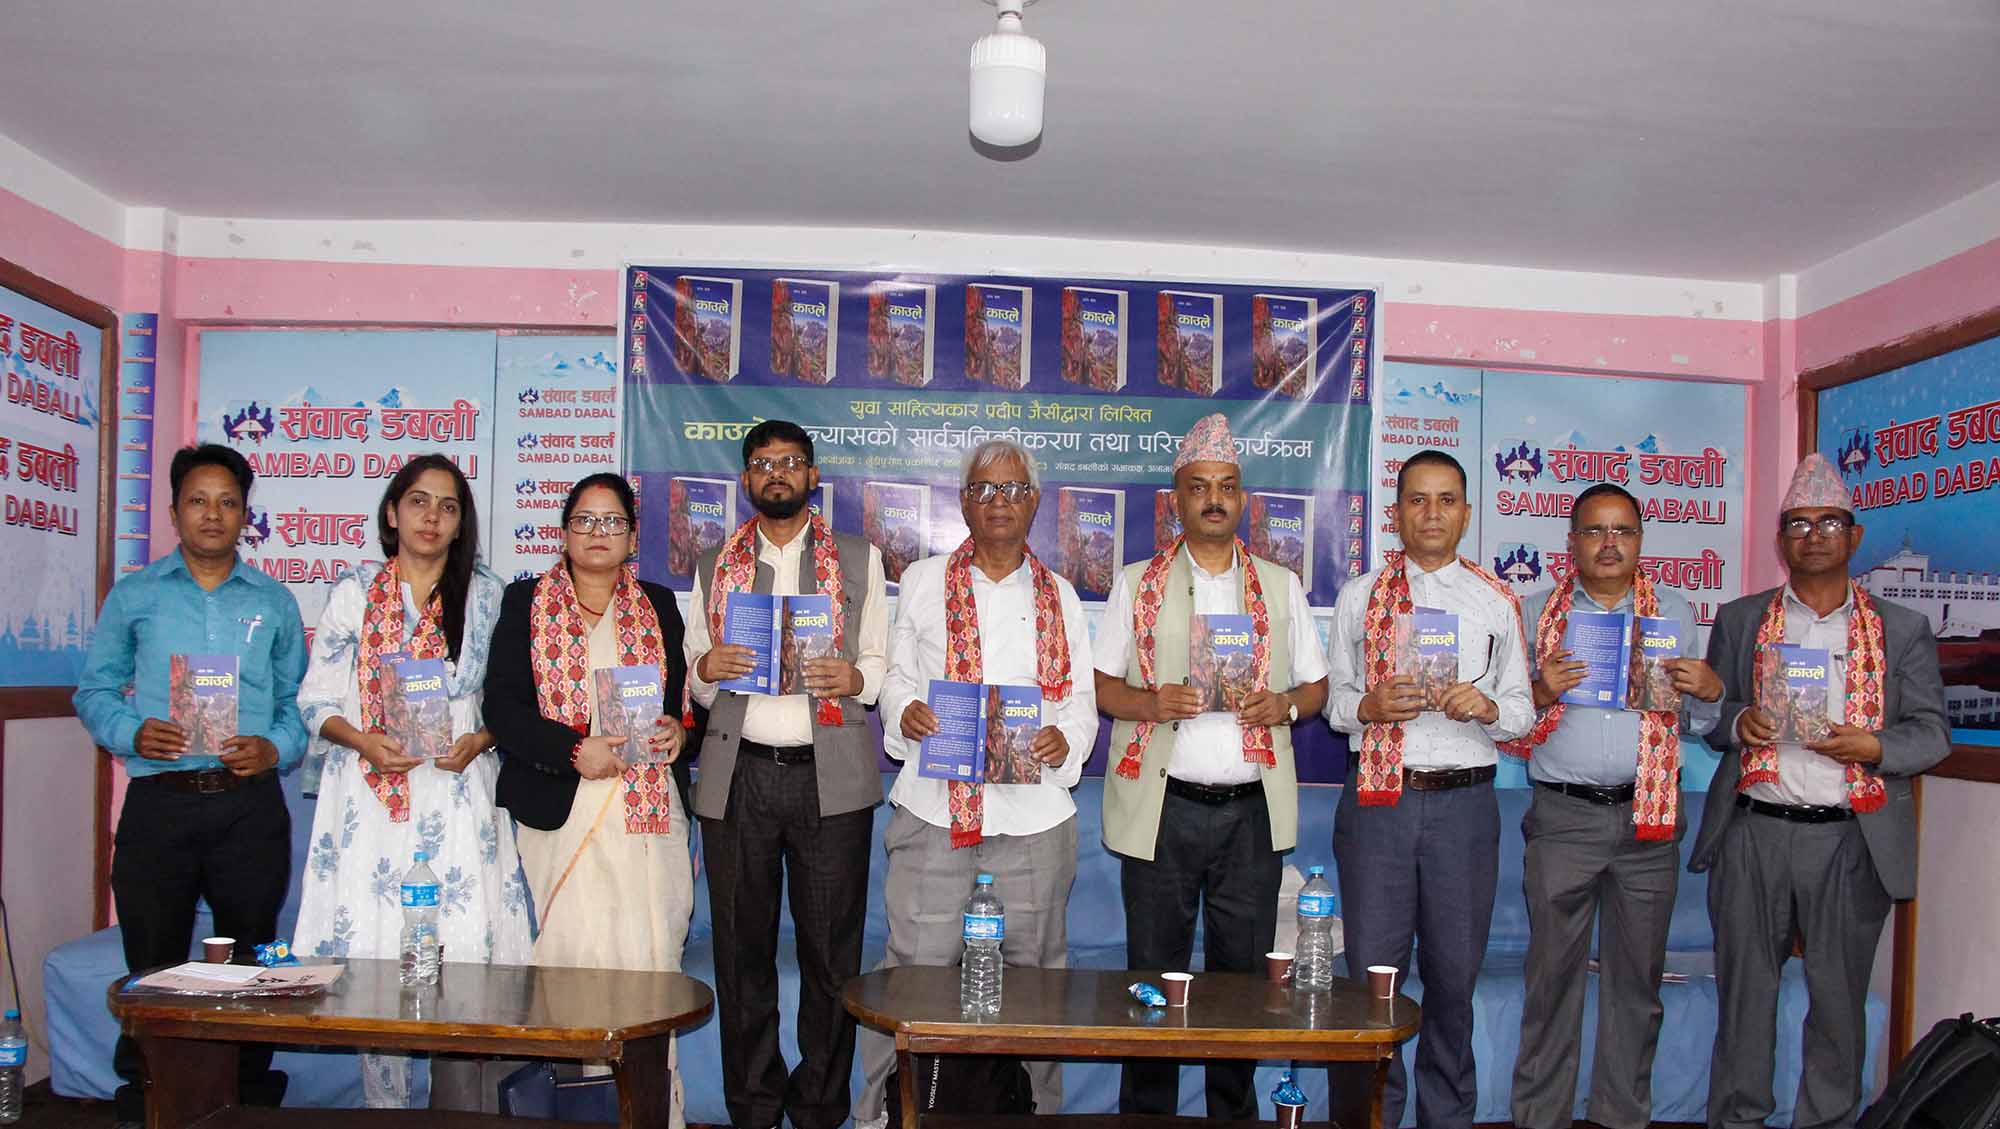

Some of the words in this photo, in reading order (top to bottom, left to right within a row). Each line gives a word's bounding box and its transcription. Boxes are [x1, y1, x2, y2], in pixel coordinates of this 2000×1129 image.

[696, 299, 729, 314] काउले
[792, 302, 826, 317] काउले
[889, 304, 923, 319] काउले
[986, 306, 1019, 321] काउले
[1083, 310, 1116, 326] काउले
[1178, 313, 1211, 328] काउले
[1272, 316, 1305, 332] काउले
[19, 321, 81, 380] डबली
[7, 372, 81, 424] DABALI
[542, 387, 577, 403] संवाद
[519, 408, 571, 418] SAMBAD
[850, 400, 880, 420] युवा
[887, 400, 978, 418] साहित्यकार
[984, 403, 1021, 420] प्रदीप
[1099, 404, 1152, 423] लिखित
[280, 401, 372, 442] संवाद
[380, 399, 480, 441] डबली
[540, 432, 576, 449] संवाद
[1090, 433, 1130, 453] तथा
[1417, 435, 1459, 448] DABALI
[1874, 416, 1942, 468] संवाद
[247, 452, 355, 479] AMBAD
[518, 453, 570, 463] SAMBAD
[1547, 443, 1632, 486] संवाद
[1639, 447, 1726, 488] डबली
[17, 441, 79, 493] डबली
[1852, 471, 1928, 512] AMBAD
[690, 500, 723, 517] काउले
[1497, 490, 1574, 517] SAMB
[5, 494, 78, 536] DABALI
[884, 504, 918, 521] काउले
[1079, 510, 1113, 526] काउले
[276, 507, 368, 548] संवाद
[1269, 515, 1302, 531] काउले
[793, 612, 828, 628] काउले
[1214, 632, 1249, 647] काउले
[1420, 632, 1455, 647] काउले
[1643, 636, 1677, 650] काउले
[195, 672, 233, 688] काउले
[1787, 666, 1825, 680] काउले
[406, 675, 443, 693] काउले
[622, 682, 658, 699] काउले
[1004, 703, 1038, 719] काउले
